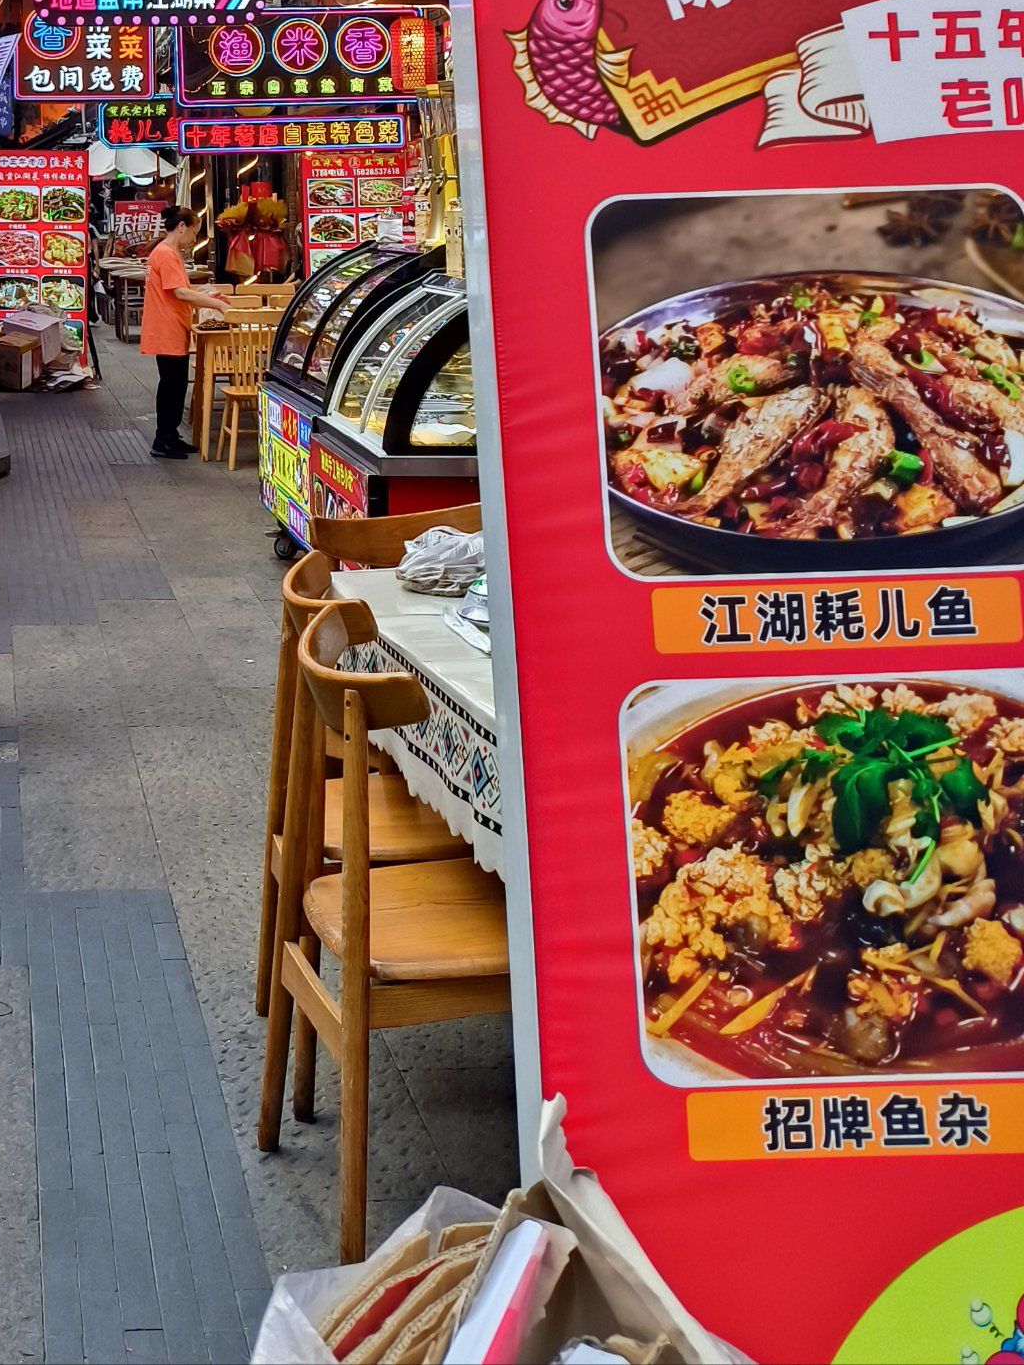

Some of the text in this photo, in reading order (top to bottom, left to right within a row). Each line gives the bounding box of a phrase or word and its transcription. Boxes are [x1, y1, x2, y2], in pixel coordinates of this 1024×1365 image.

[85, 26, 112, 60] 菜
[119, 26, 144, 60] 菜
[218, 27, 383, 66] 渔米香
[24, 64, 145, 94] 包间免费
[698, 585, 979, 646] 江湖耗儿鱼
[761, 1090, 991, 1153] 招牌鱼杂
